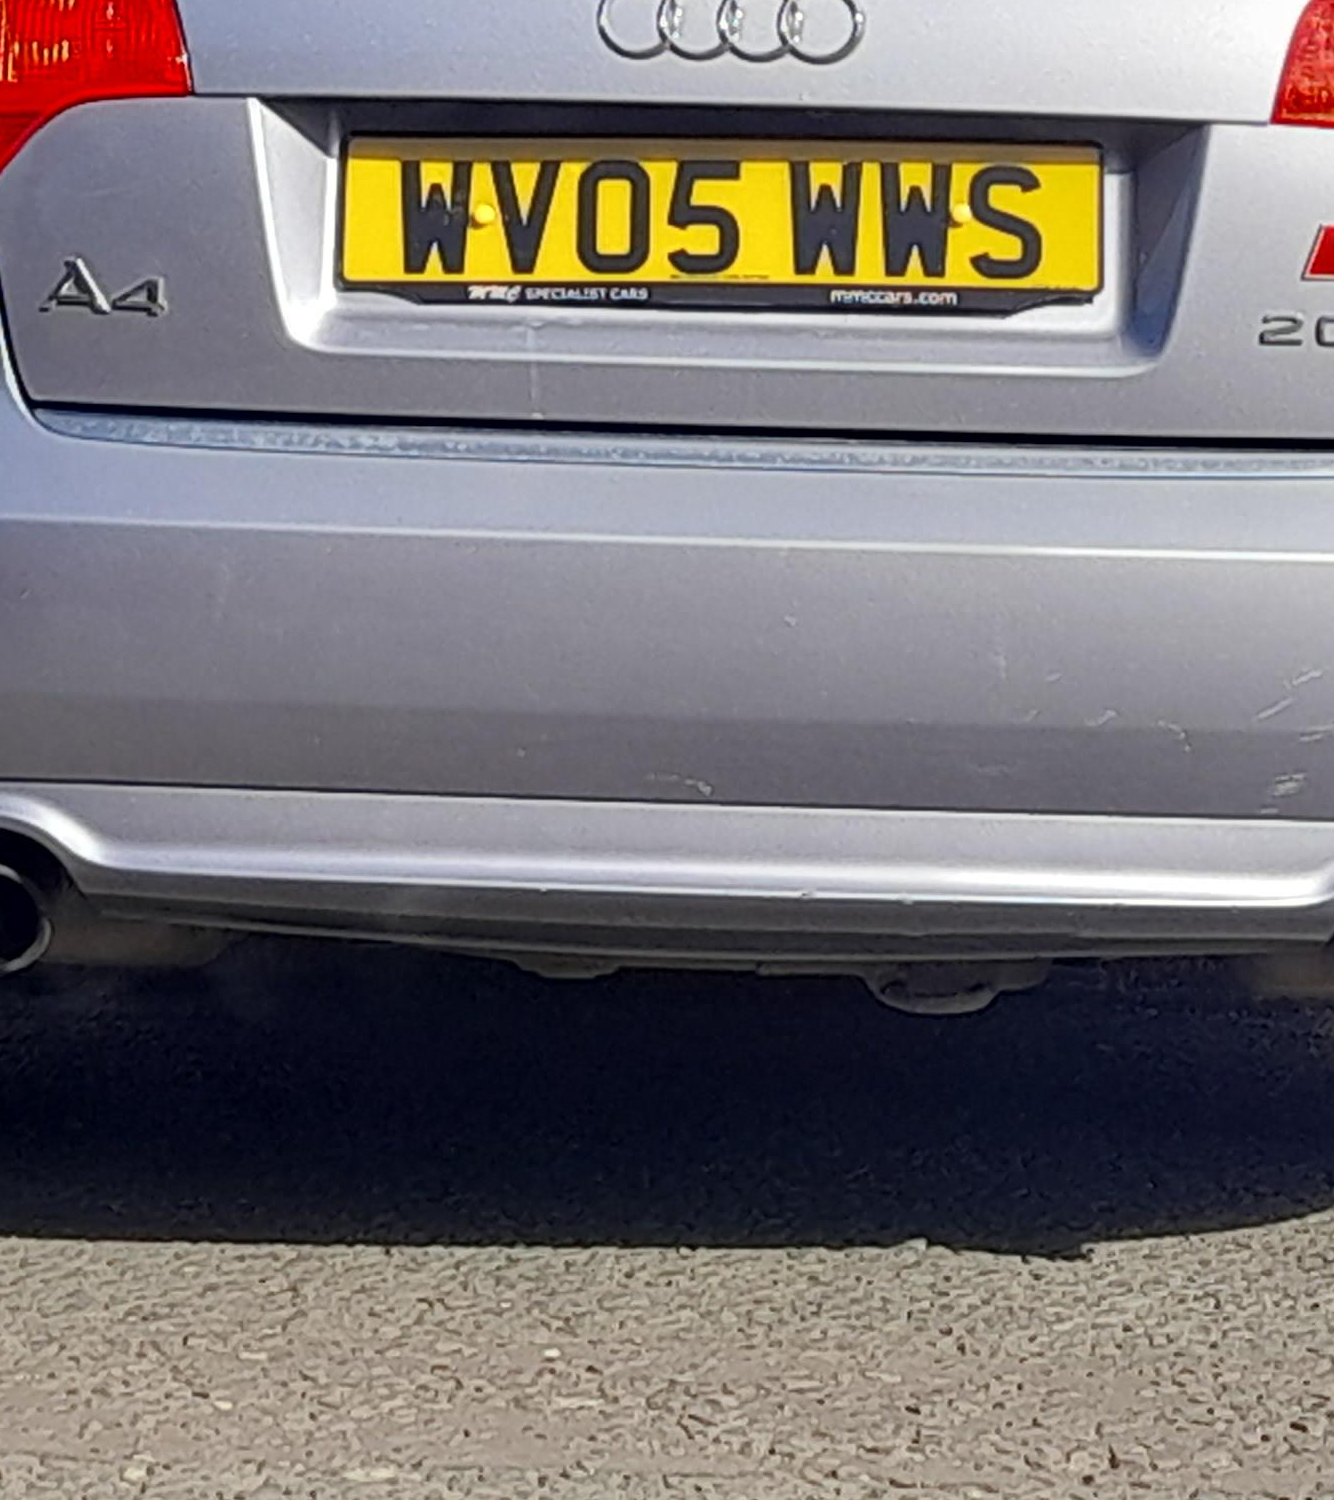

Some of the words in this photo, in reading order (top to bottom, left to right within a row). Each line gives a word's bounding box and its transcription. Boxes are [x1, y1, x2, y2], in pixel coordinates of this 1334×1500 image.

[400, 160, 742, 276] WV05
[788, 160, 1042, 279] WWS
[38, 257, 168, 317] A4
[525, 286, 607, 300] SPECIALIST
[610, 287, 649, 301] CARS
[830, 289, 957, 306] mmccars.com
